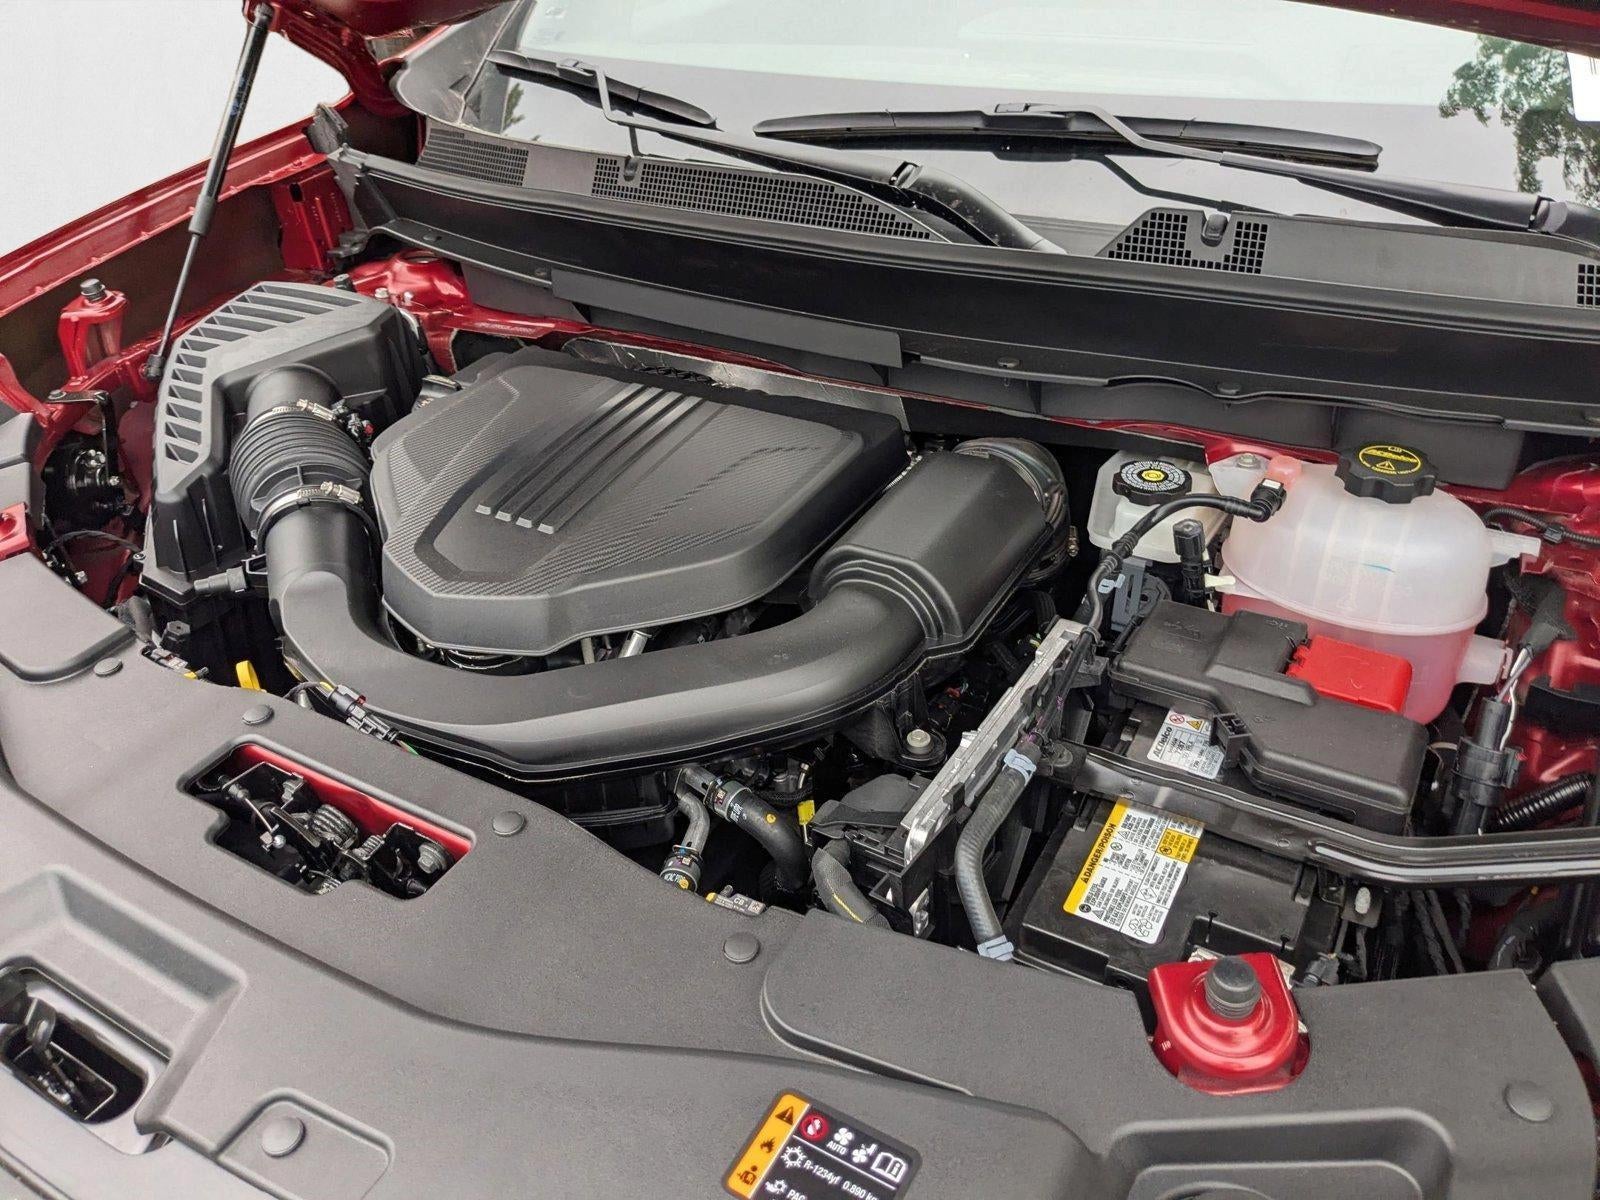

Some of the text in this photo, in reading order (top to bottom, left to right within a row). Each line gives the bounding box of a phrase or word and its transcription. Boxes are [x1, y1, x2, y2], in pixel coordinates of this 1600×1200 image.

[1152, 726, 1173, 758] ACDelco
[1082, 822, 1116, 878] DANGER/POISON
[826, 1141, 847, 1156] AUTO
[803, 1160, 841, 1185] R-1234yf
[842, 1180, 866, 1198] 0.890
